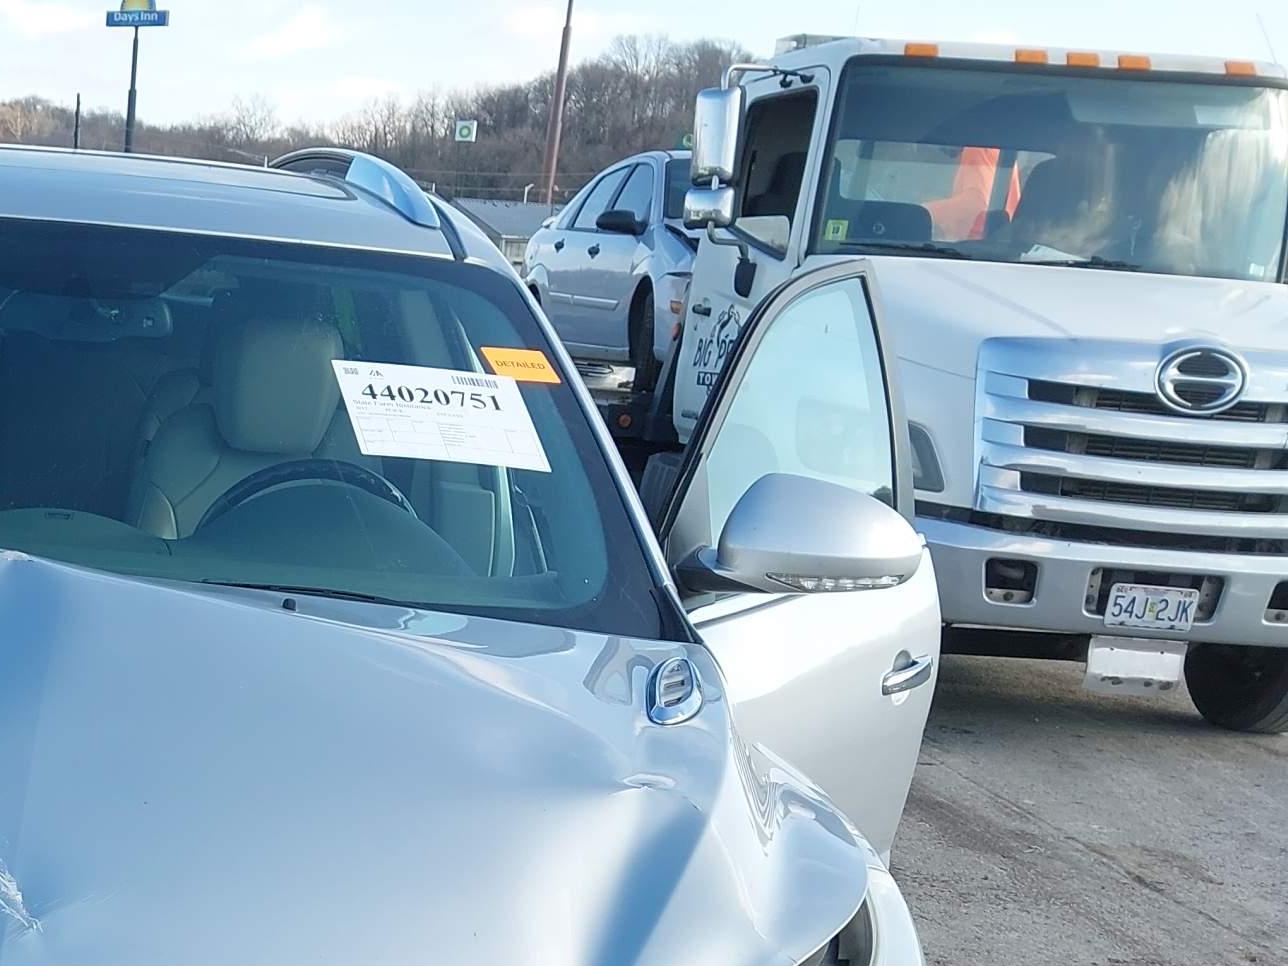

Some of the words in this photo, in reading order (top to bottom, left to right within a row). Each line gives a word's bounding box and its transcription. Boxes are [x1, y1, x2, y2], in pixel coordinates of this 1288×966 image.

[113, 12, 139, 22] Days
[140, 11, 159, 21] Inn
[495, 360, 546, 370] DETAILED
[693, 337, 714, 368] BIG
[362, 383, 504, 411] 44020751
[1111, 594, 1150, 620] 54J
[1155, 598, 1194, 623] 2JK
